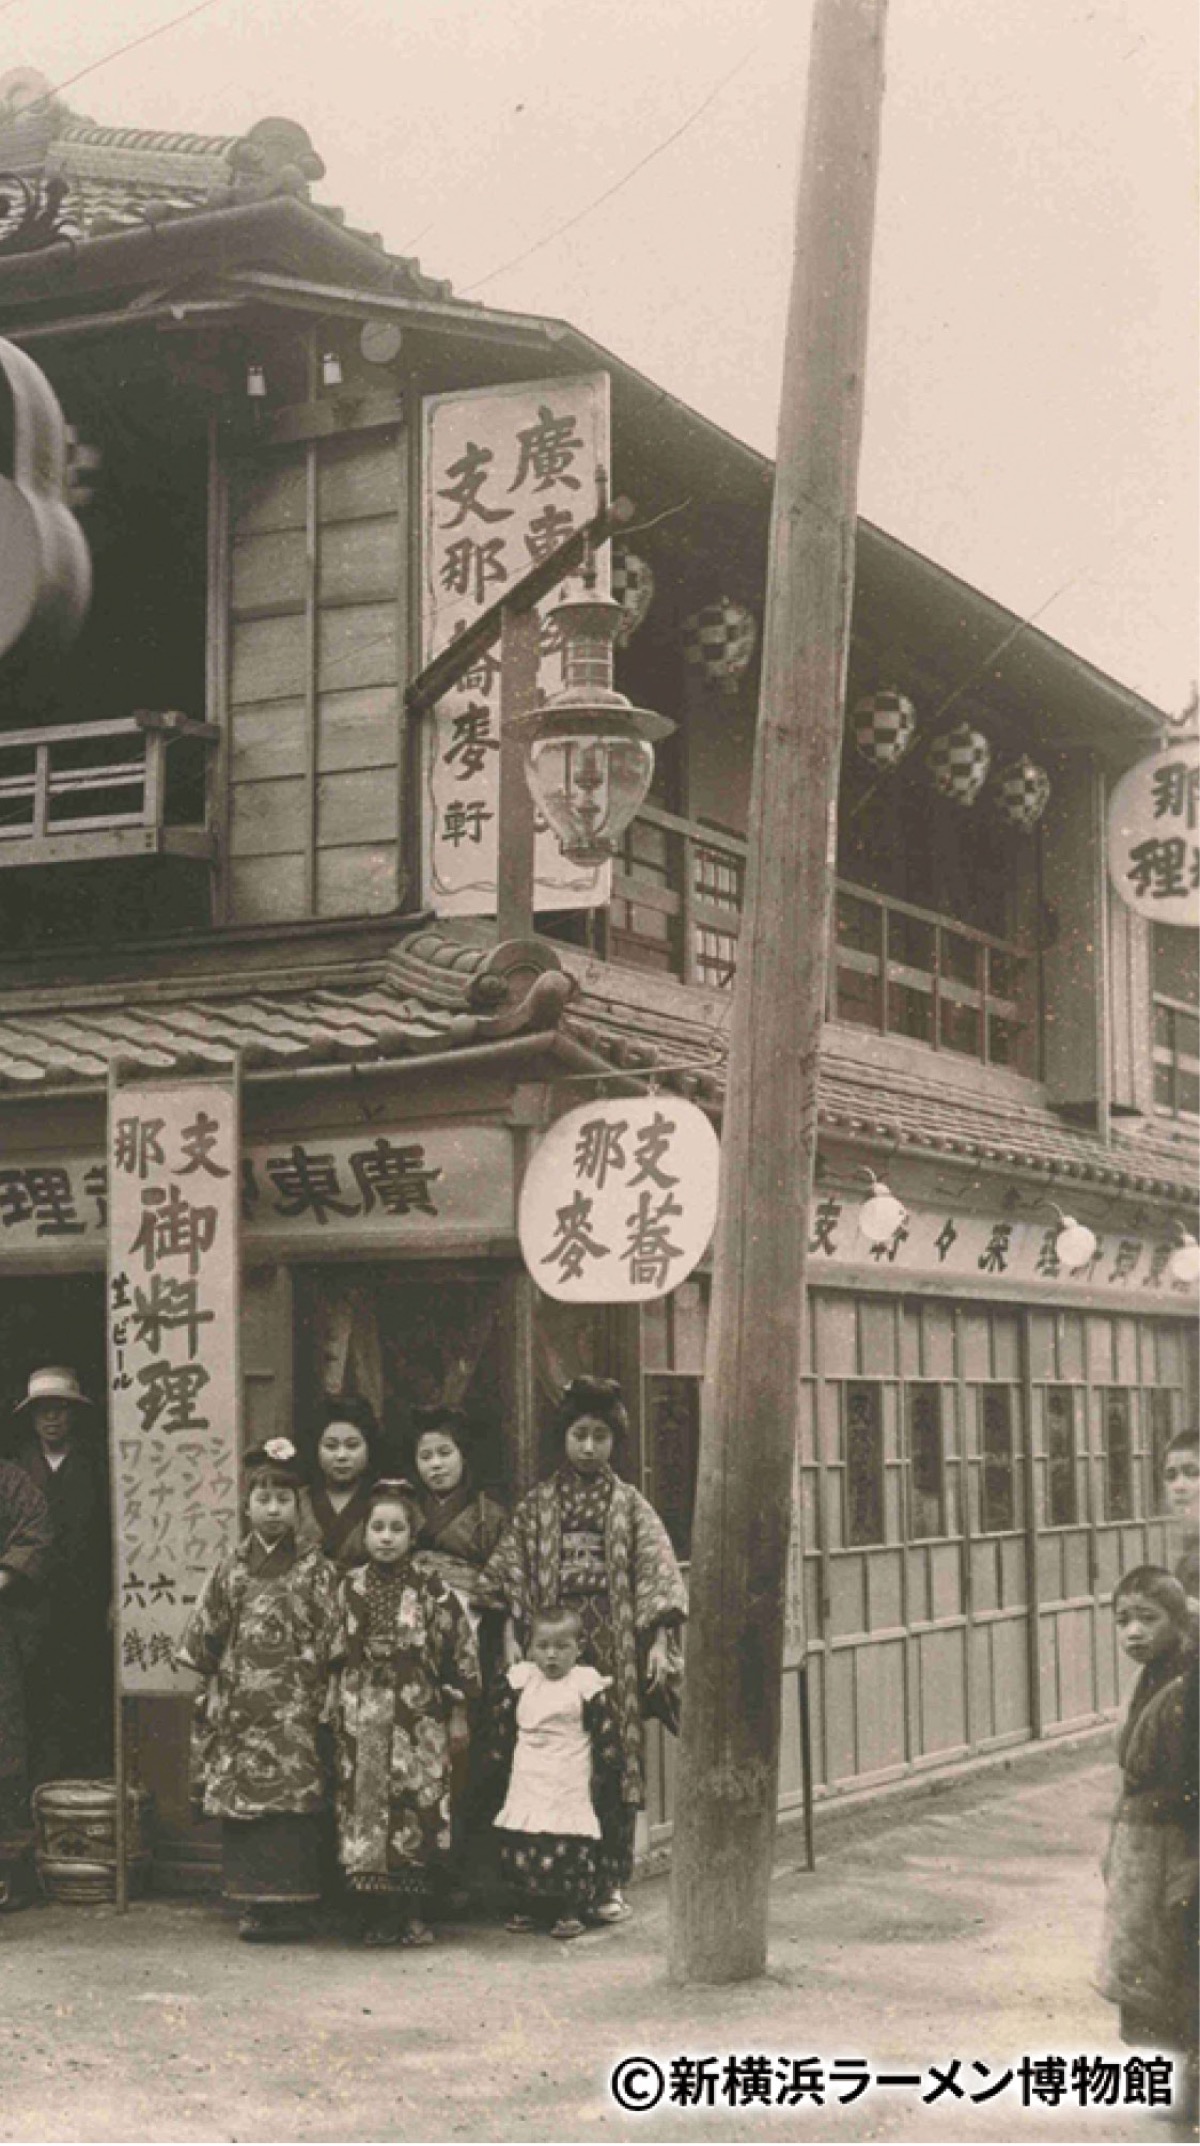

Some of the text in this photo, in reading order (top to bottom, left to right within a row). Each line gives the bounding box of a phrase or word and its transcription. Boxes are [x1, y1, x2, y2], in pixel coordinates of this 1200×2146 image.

[113, 1111, 231, 1180] 支那
[573, 1111, 681, 1190] 支那
[129, 1184, 218, 1435] 御料理
